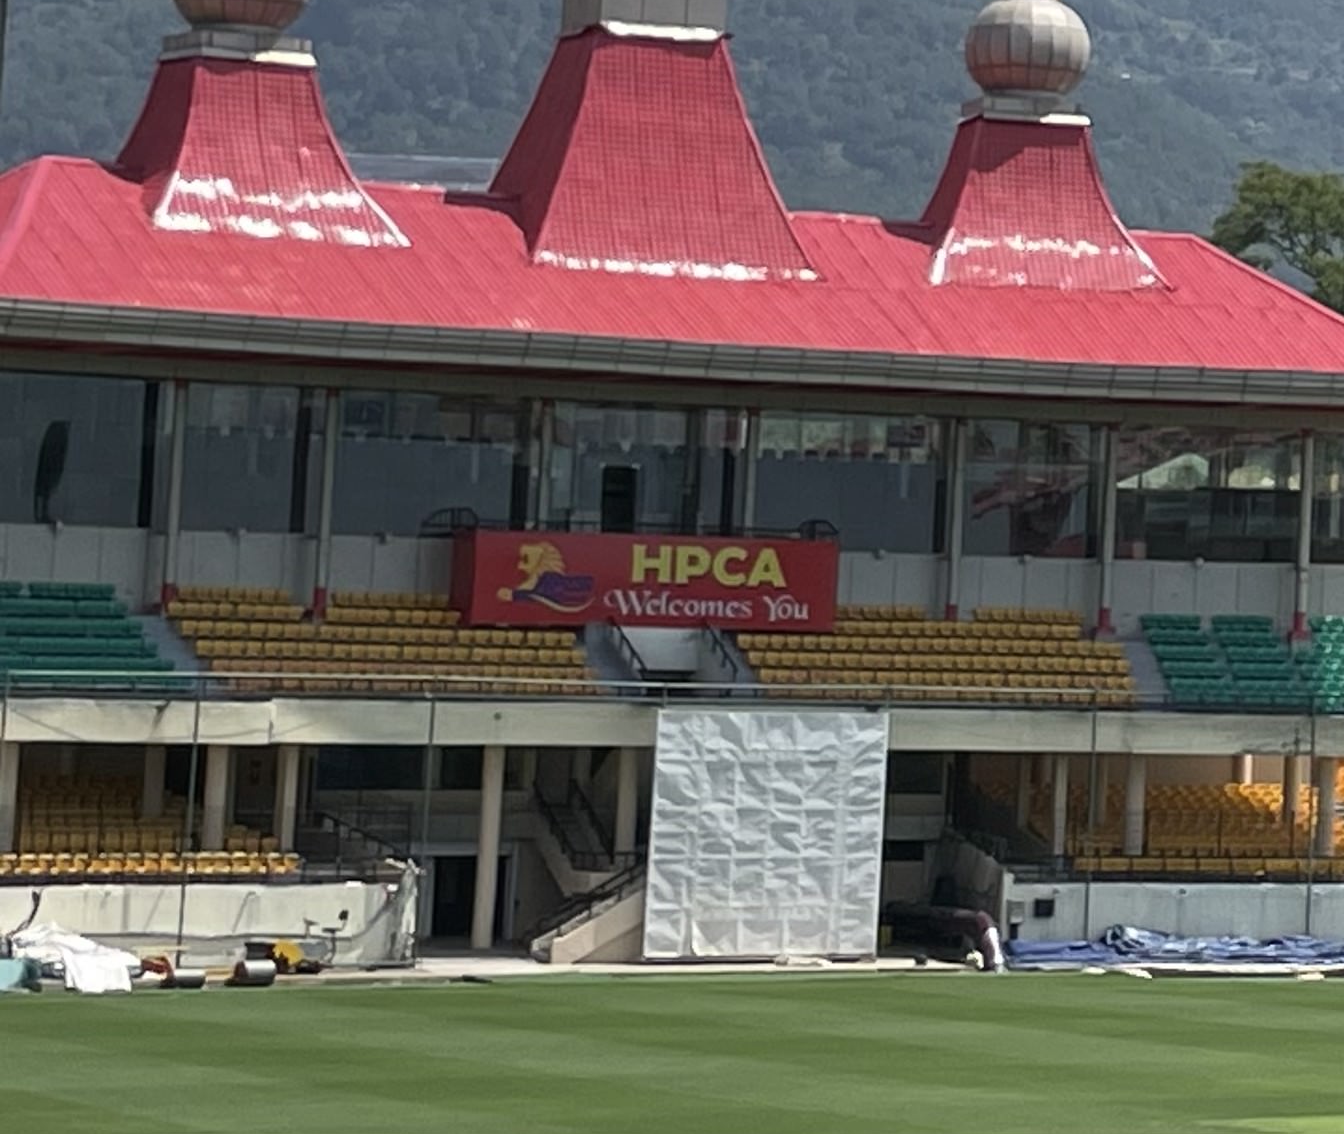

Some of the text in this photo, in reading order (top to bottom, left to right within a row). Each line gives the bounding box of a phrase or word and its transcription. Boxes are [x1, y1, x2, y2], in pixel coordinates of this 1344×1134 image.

[631, 543, 787, 588] HPCA
[603, 589, 809, 622] Welcomes You
